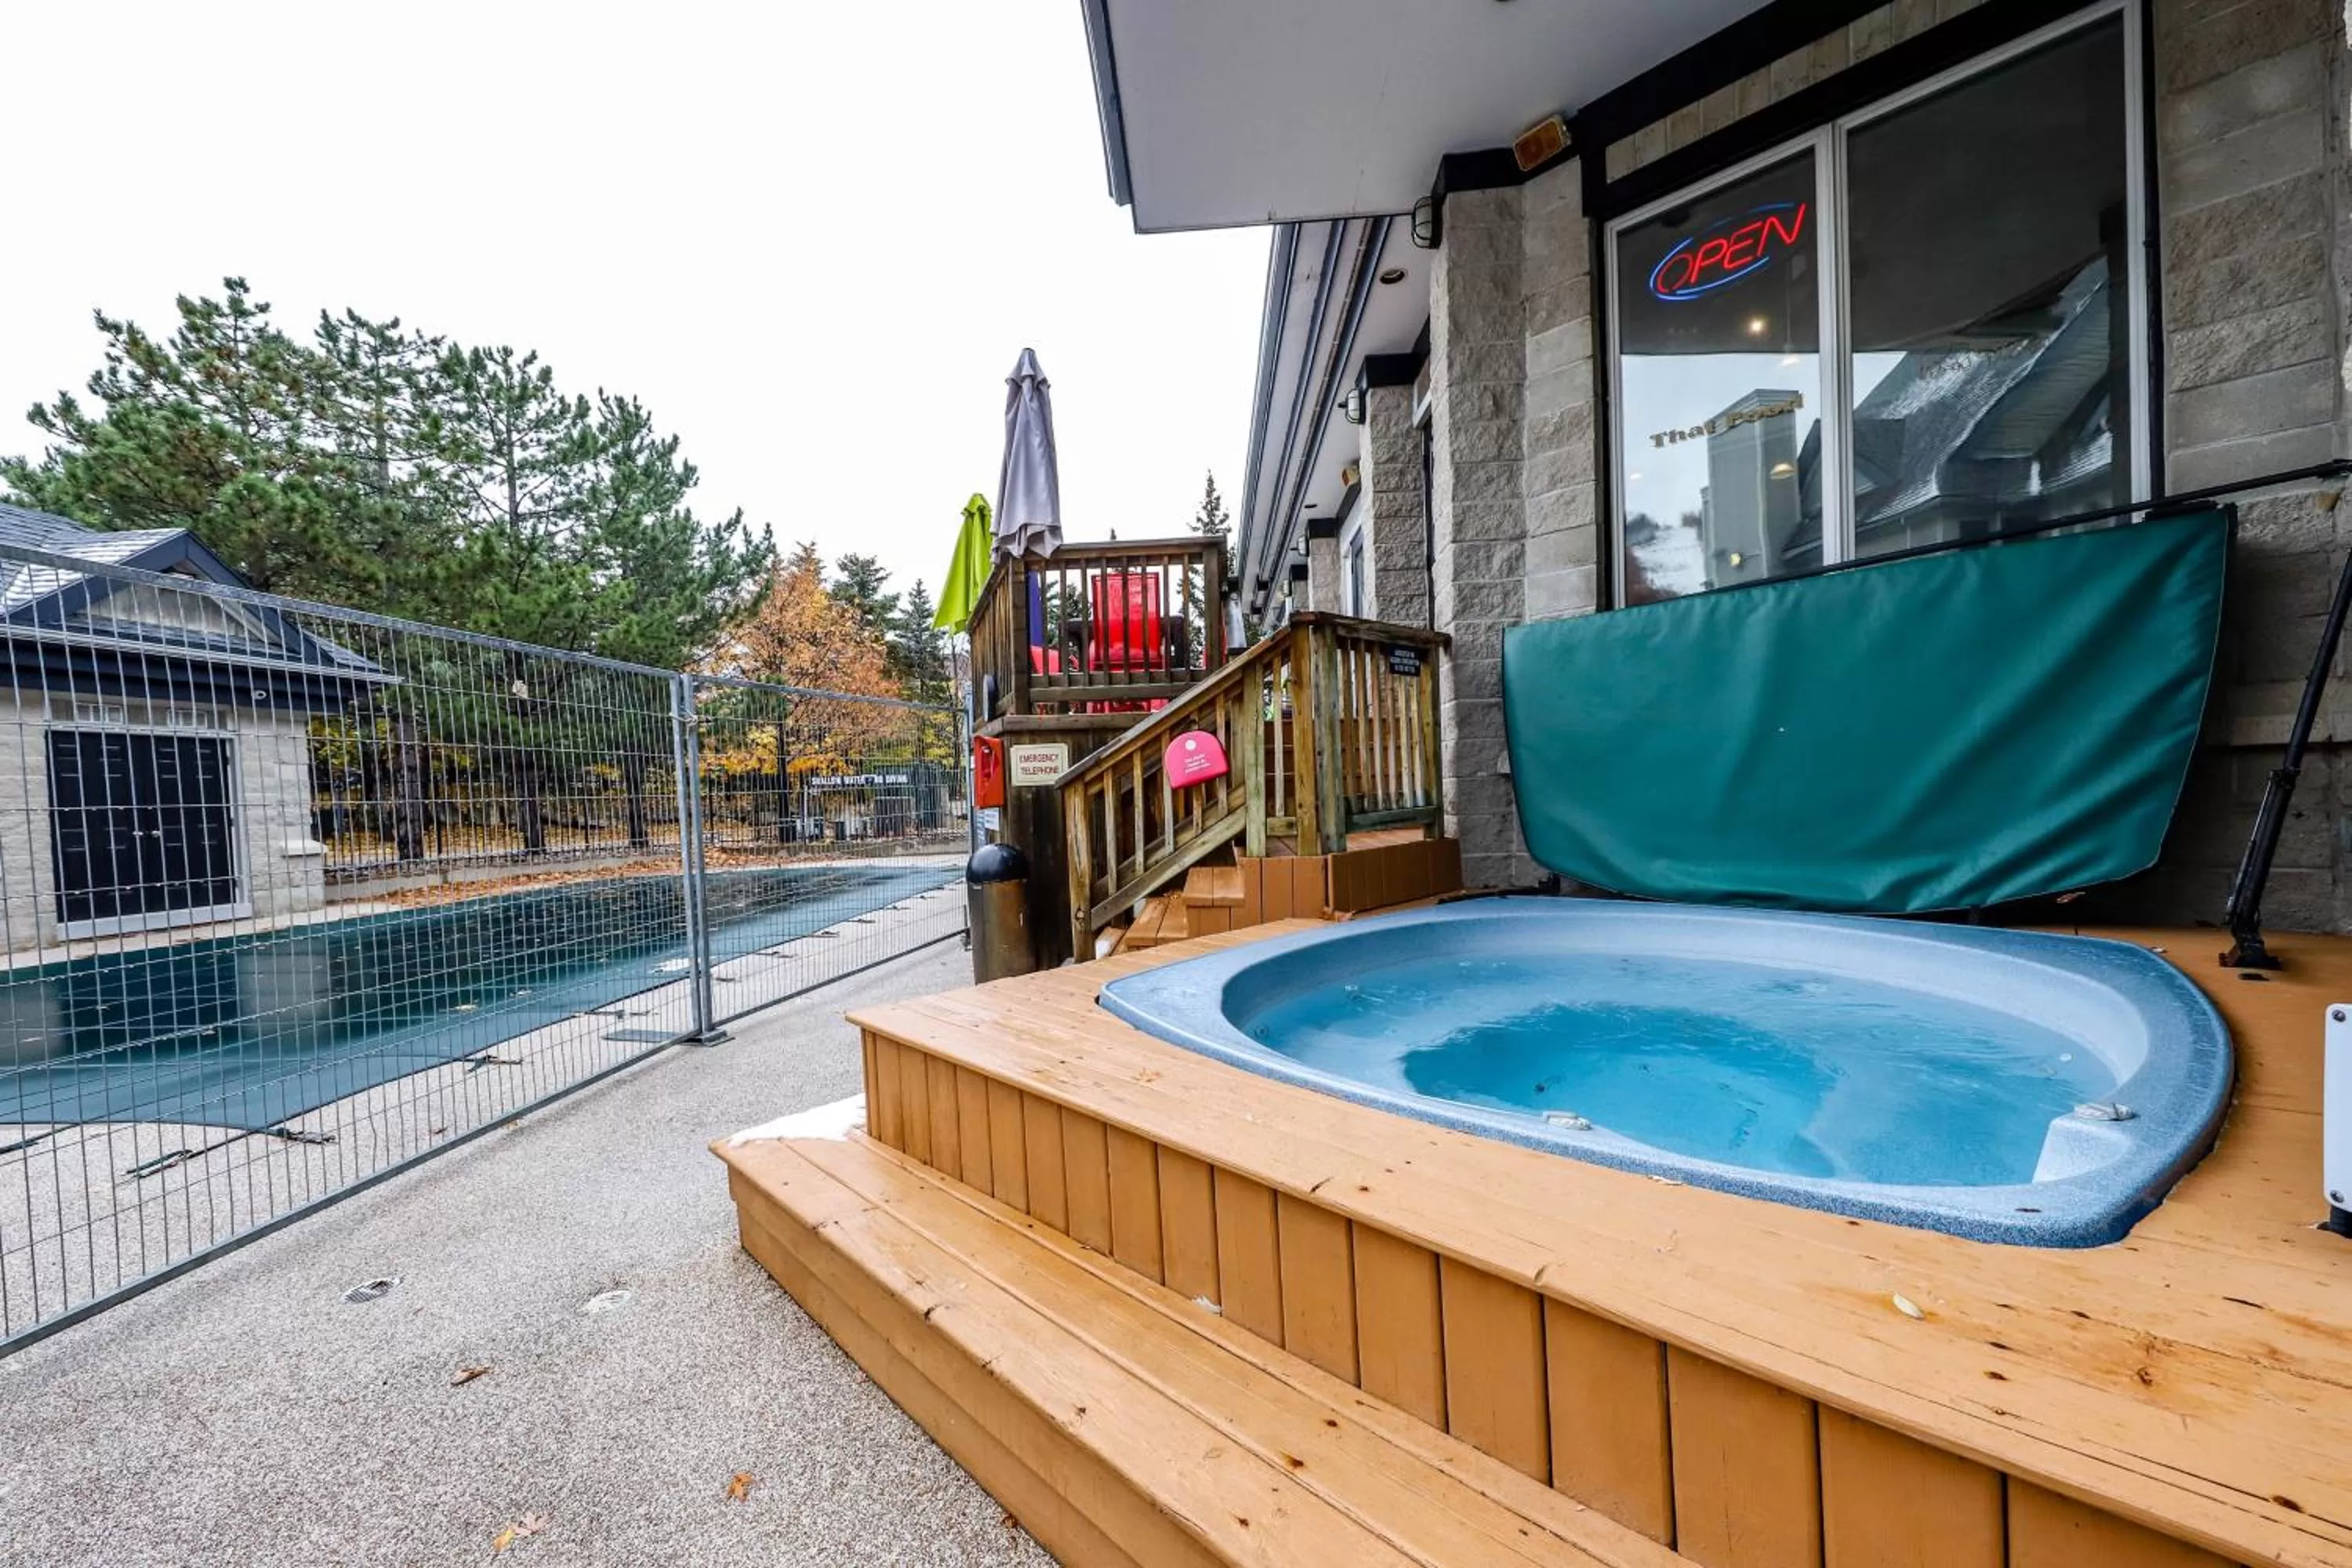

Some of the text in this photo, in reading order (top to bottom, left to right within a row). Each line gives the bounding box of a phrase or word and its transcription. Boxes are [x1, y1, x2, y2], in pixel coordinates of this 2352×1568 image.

[1656, 202, 1806, 293] OPEN
[1019, 753, 1059, 763] EMERGENCY
[1020, 765, 1060, 775] TELEPHONE
